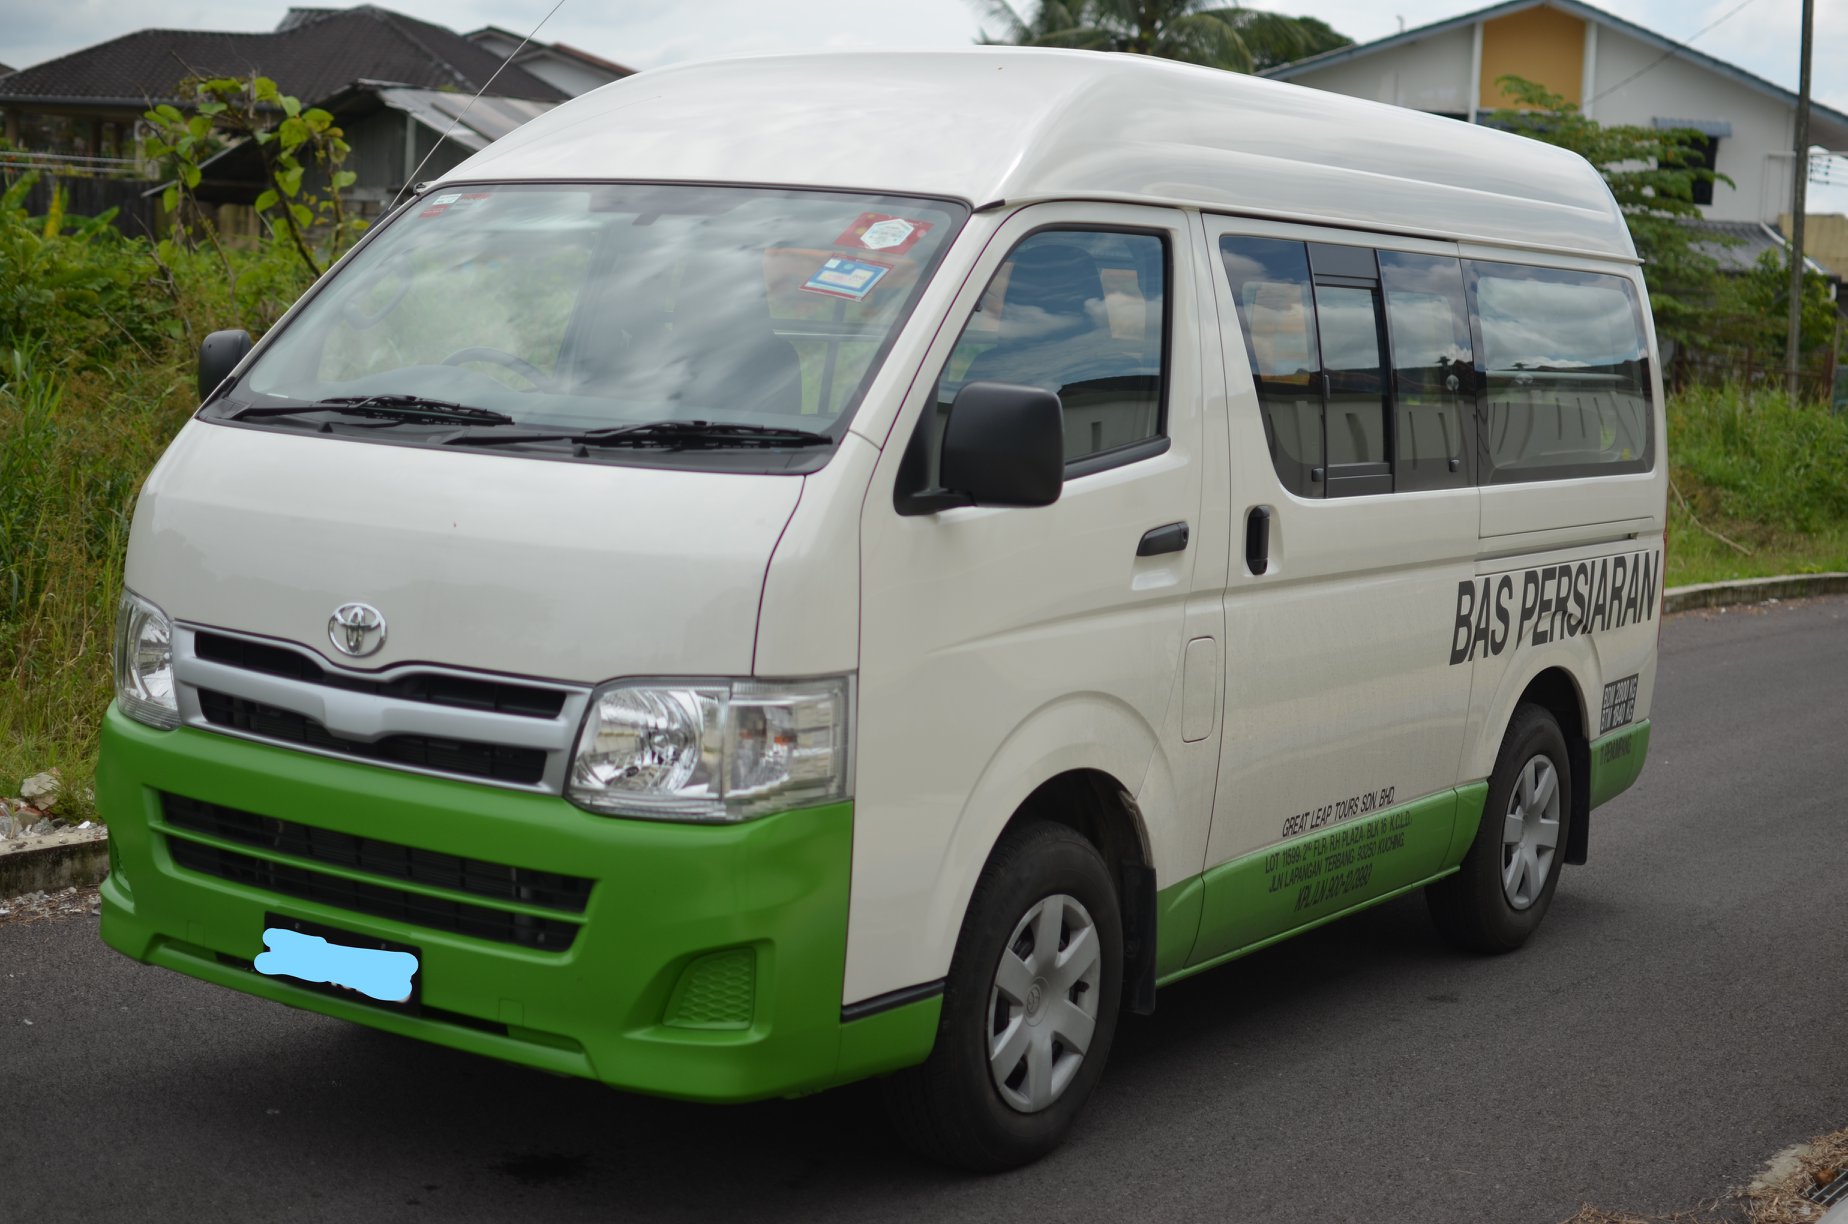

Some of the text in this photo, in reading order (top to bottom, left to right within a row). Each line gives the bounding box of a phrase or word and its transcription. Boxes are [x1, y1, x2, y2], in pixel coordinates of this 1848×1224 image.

[1449, 550, 1659, 665] BAS PERSIARAN
[1282, 811, 1310, 837] GREAT
[1310, 804, 1332, 829] LEAP
[1334, 796, 1359, 821] TOURS
[1265, 851, 1280, 875] LOT
[1367, 819, 1380, 840] BLK
[1285, 858, 1322, 888] LAPANGAN
